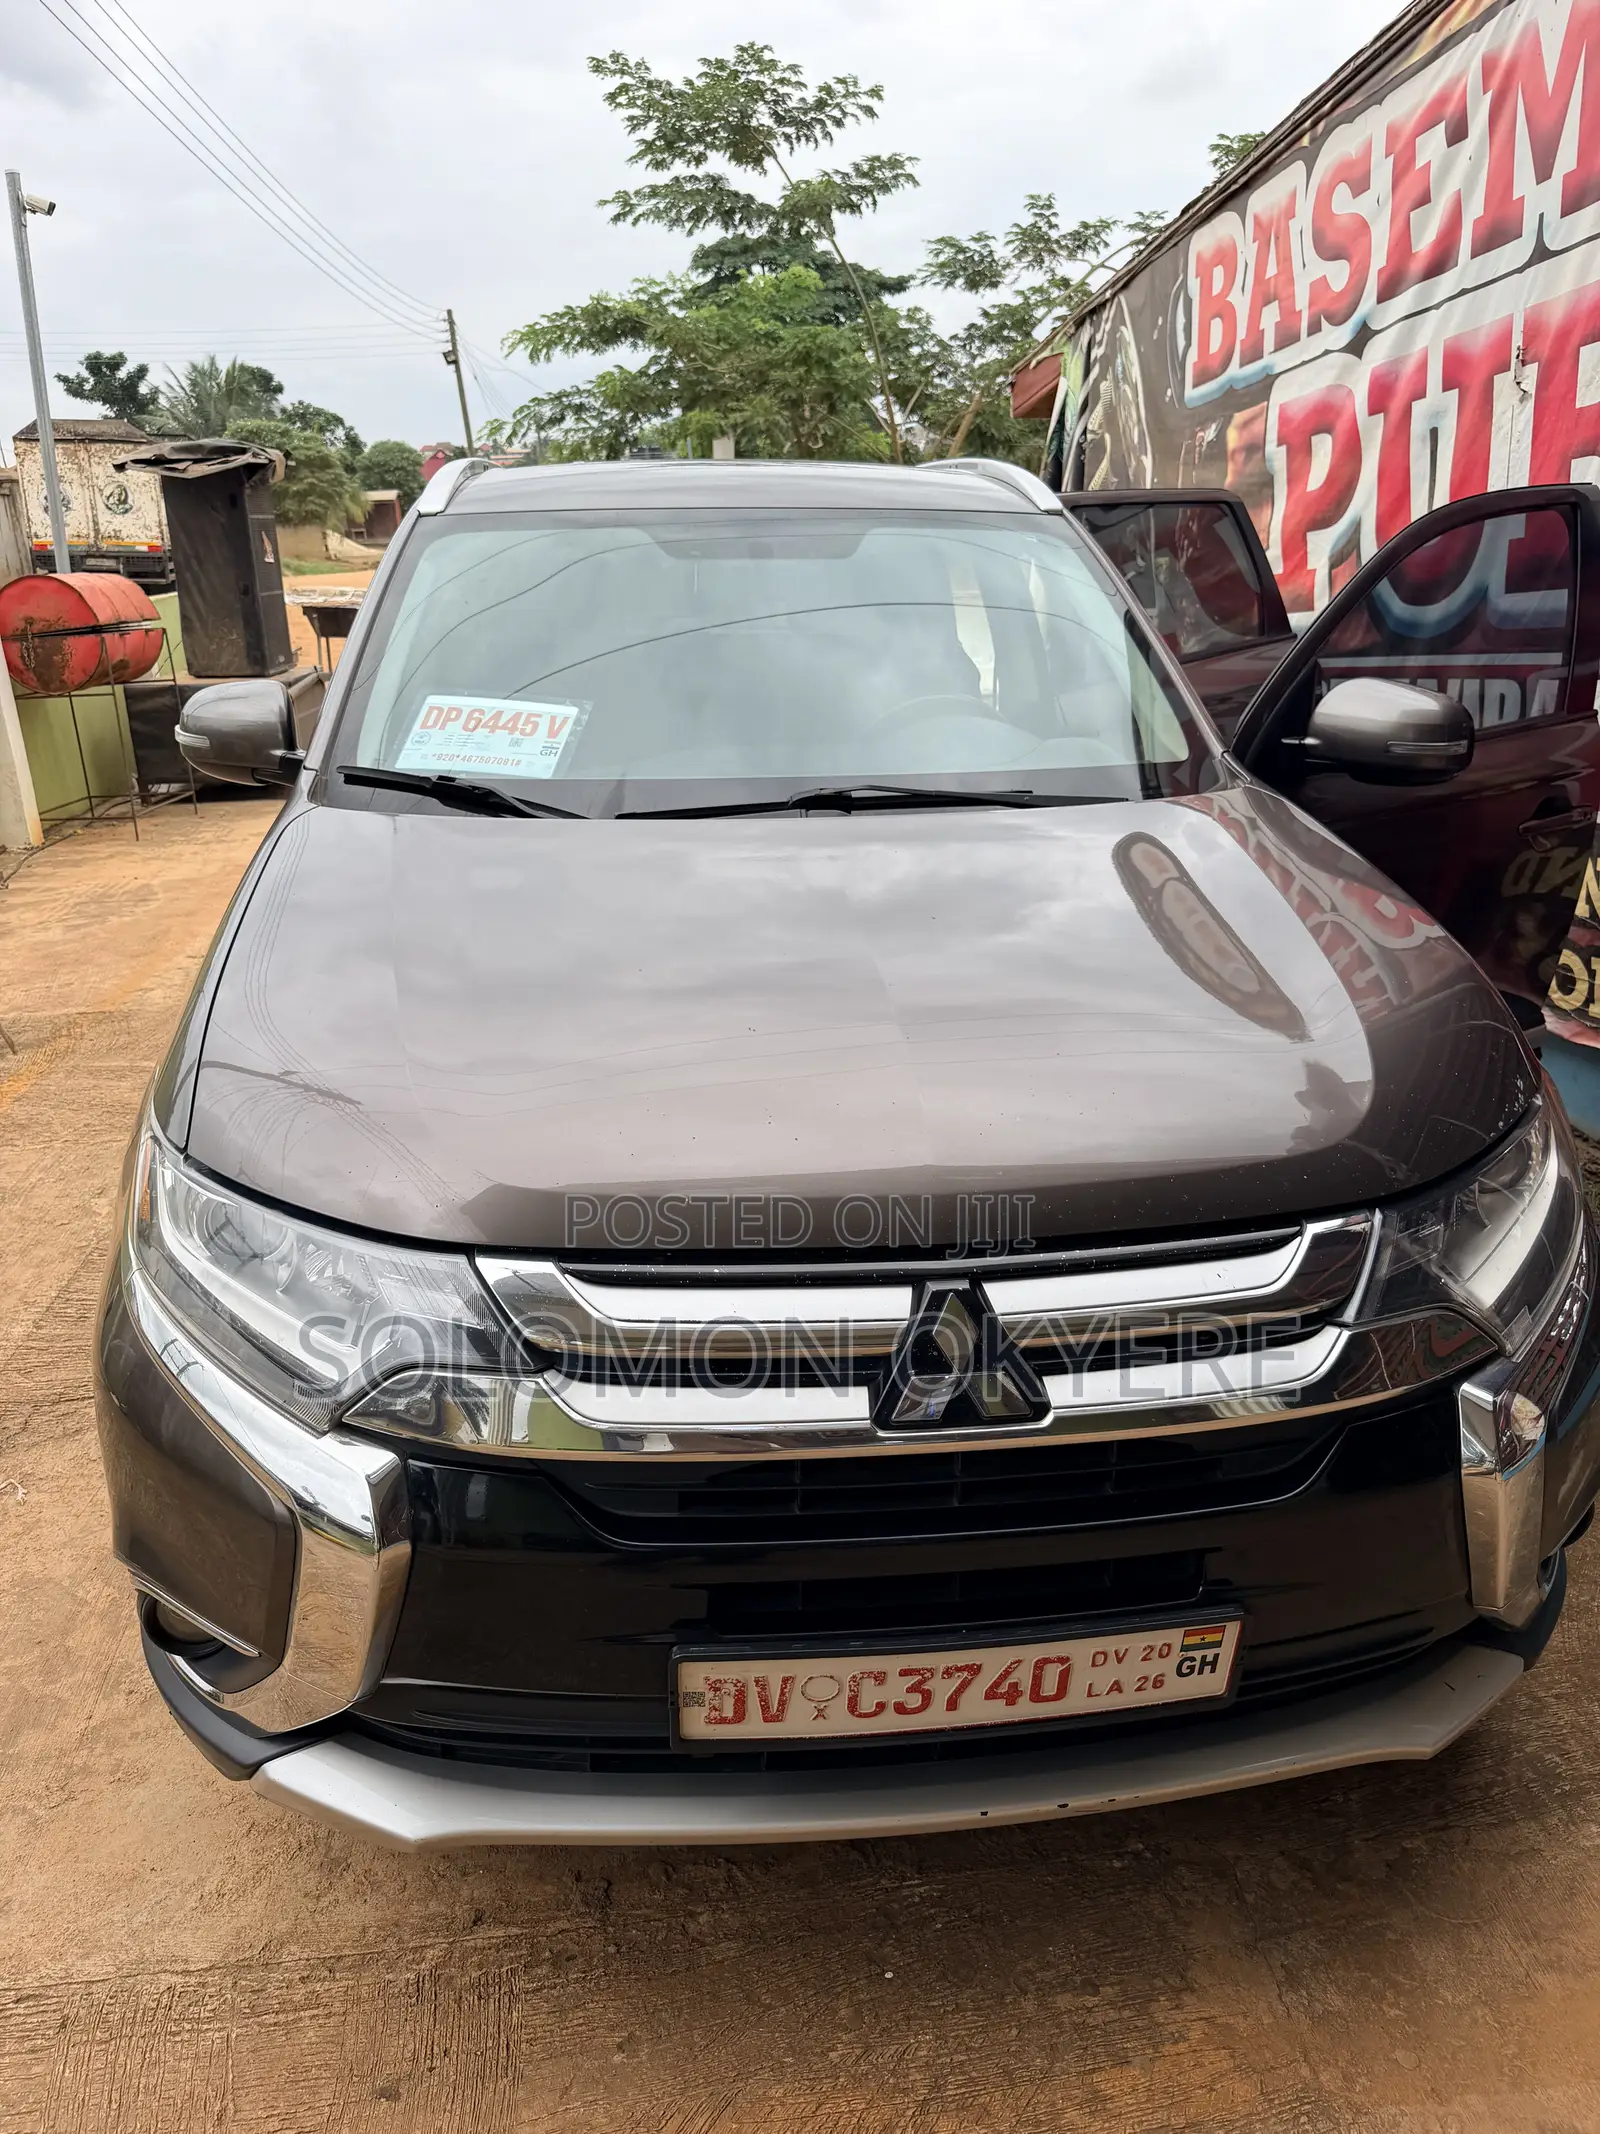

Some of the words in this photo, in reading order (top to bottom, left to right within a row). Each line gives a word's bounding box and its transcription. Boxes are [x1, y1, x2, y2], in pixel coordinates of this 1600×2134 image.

[420, 705, 463, 731] DP
[461, 708, 543, 737] 6445
[546, 715, 570, 740] V
[540, 749, 558, 757] GH
[1091, 1648, 1129, 1668] DV
[1141, 1643, 1172, 1662] 20
[1175, 1653, 1220, 1678] GH
[703, 1674, 797, 1724] DV
[846, 1655, 1072, 1719] C3740
[1086, 1679, 1124, 1698] LA
[1134, 1673, 1166, 1692] 26
